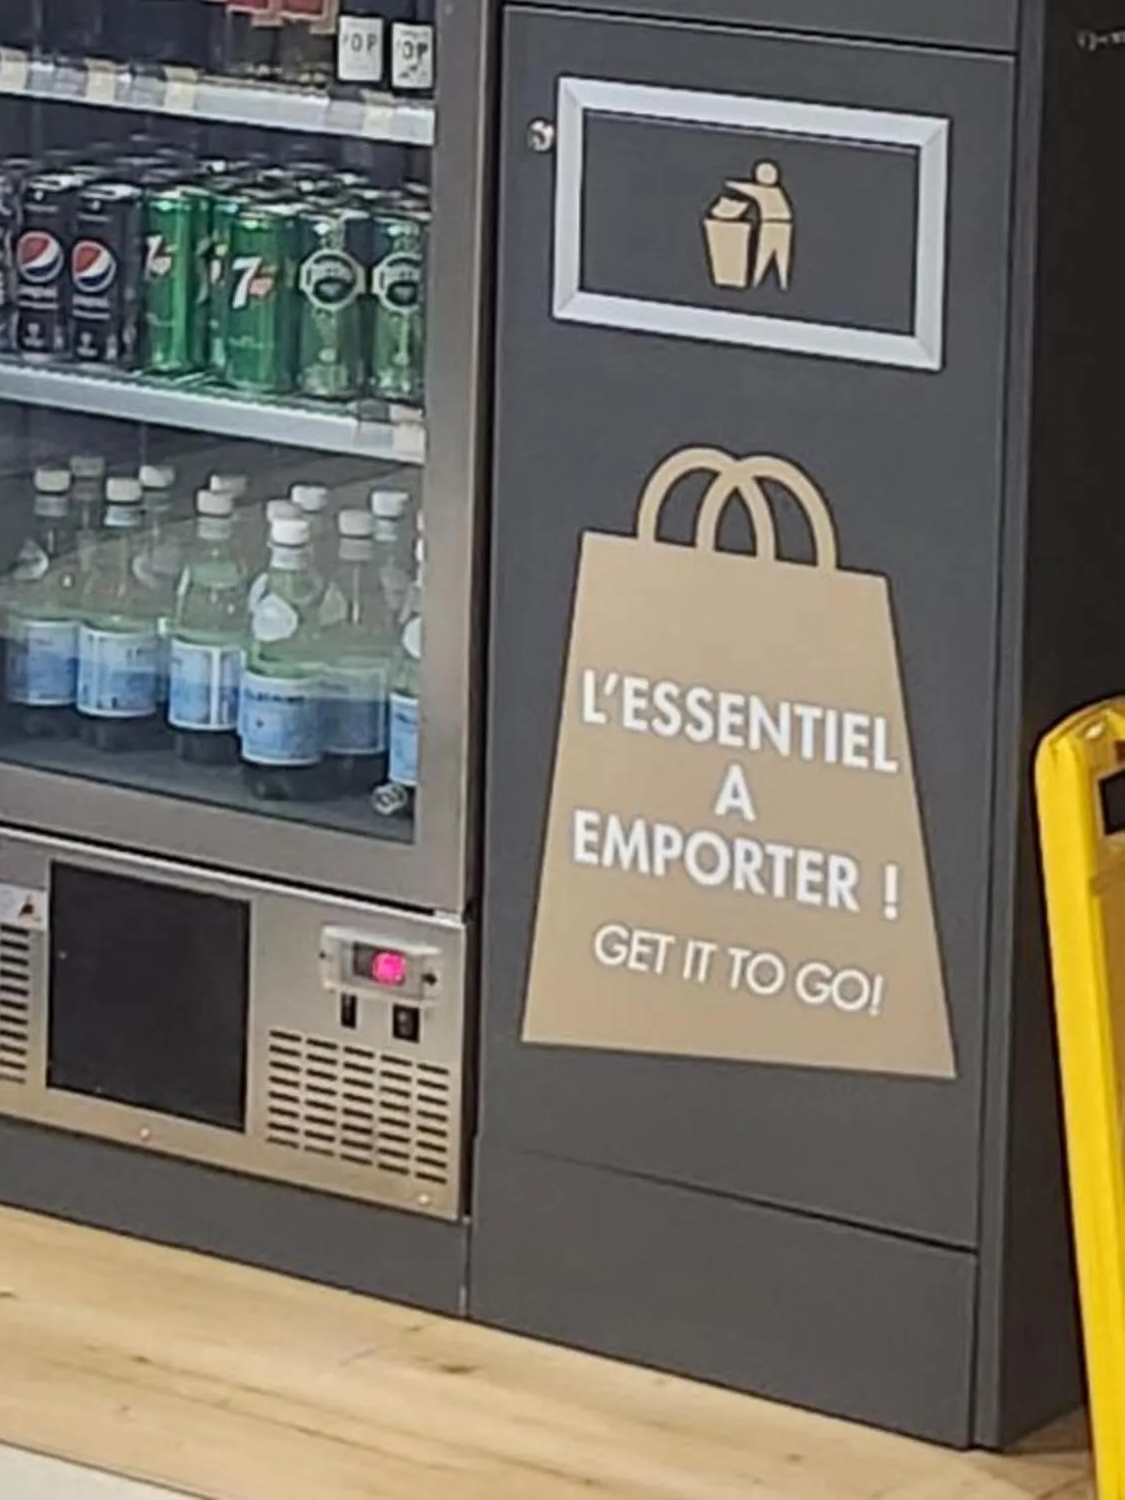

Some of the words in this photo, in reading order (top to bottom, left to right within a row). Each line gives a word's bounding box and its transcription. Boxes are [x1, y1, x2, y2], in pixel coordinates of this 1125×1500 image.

[715, 763, 756, 822] A
[573, 809, 860, 912] EMPORTER
[883, 864, 898, 921] !
[594, 924, 675, 974] GET
[683, 939, 715, 982] IT
[728, 947, 785, 996] TO
[796, 962, 884, 1016] GO!
